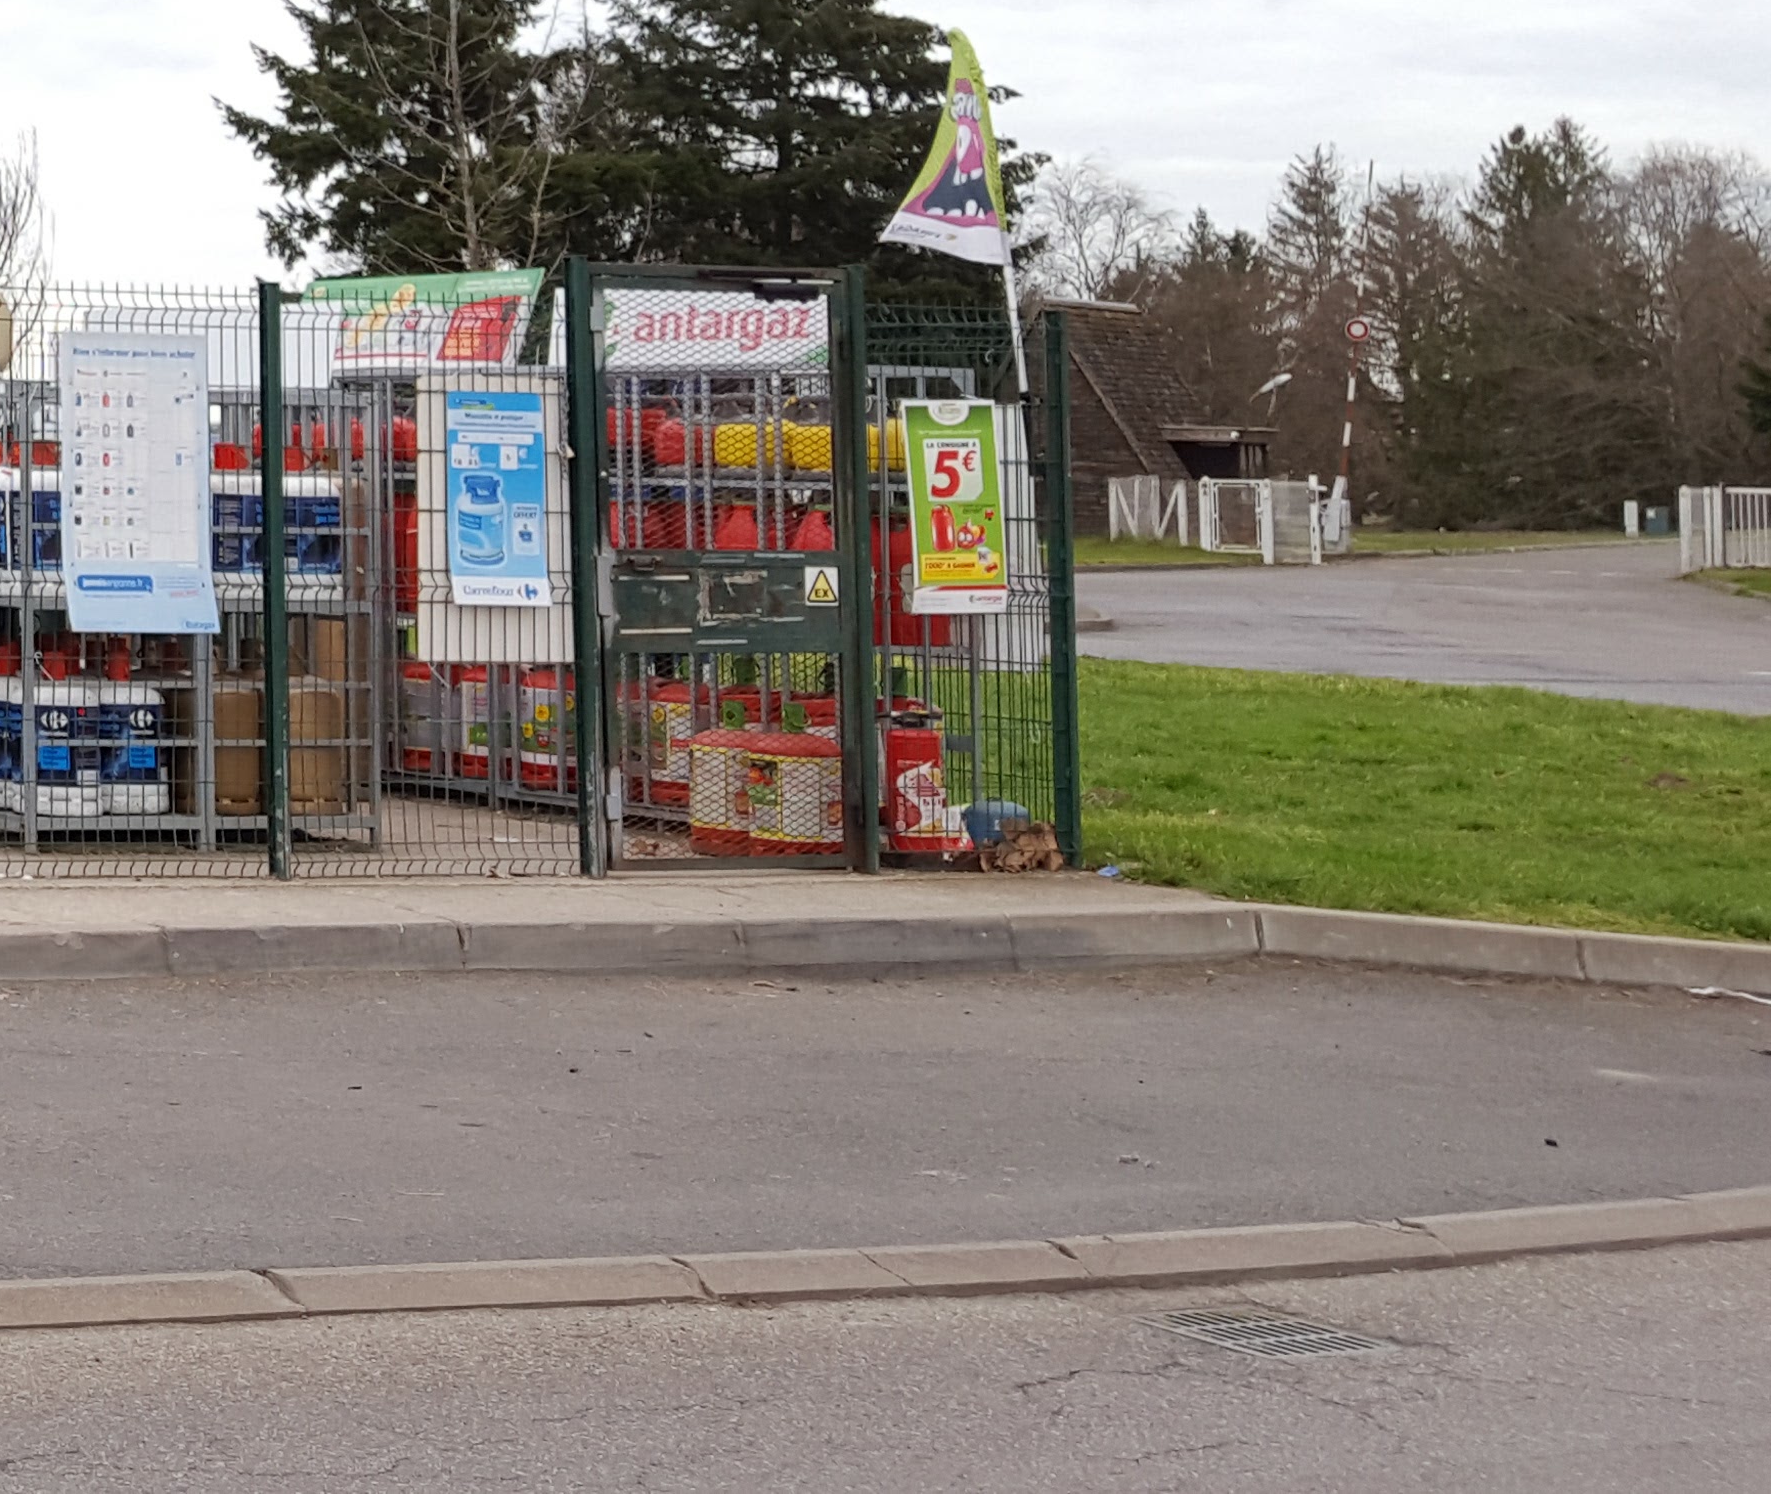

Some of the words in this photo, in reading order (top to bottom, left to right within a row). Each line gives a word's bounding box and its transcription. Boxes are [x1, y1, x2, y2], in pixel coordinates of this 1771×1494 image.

[634, 305, 810, 352] antargaz
[463, 585, 514, 597] Carrefour
[814, 588, 829, 598] EX
